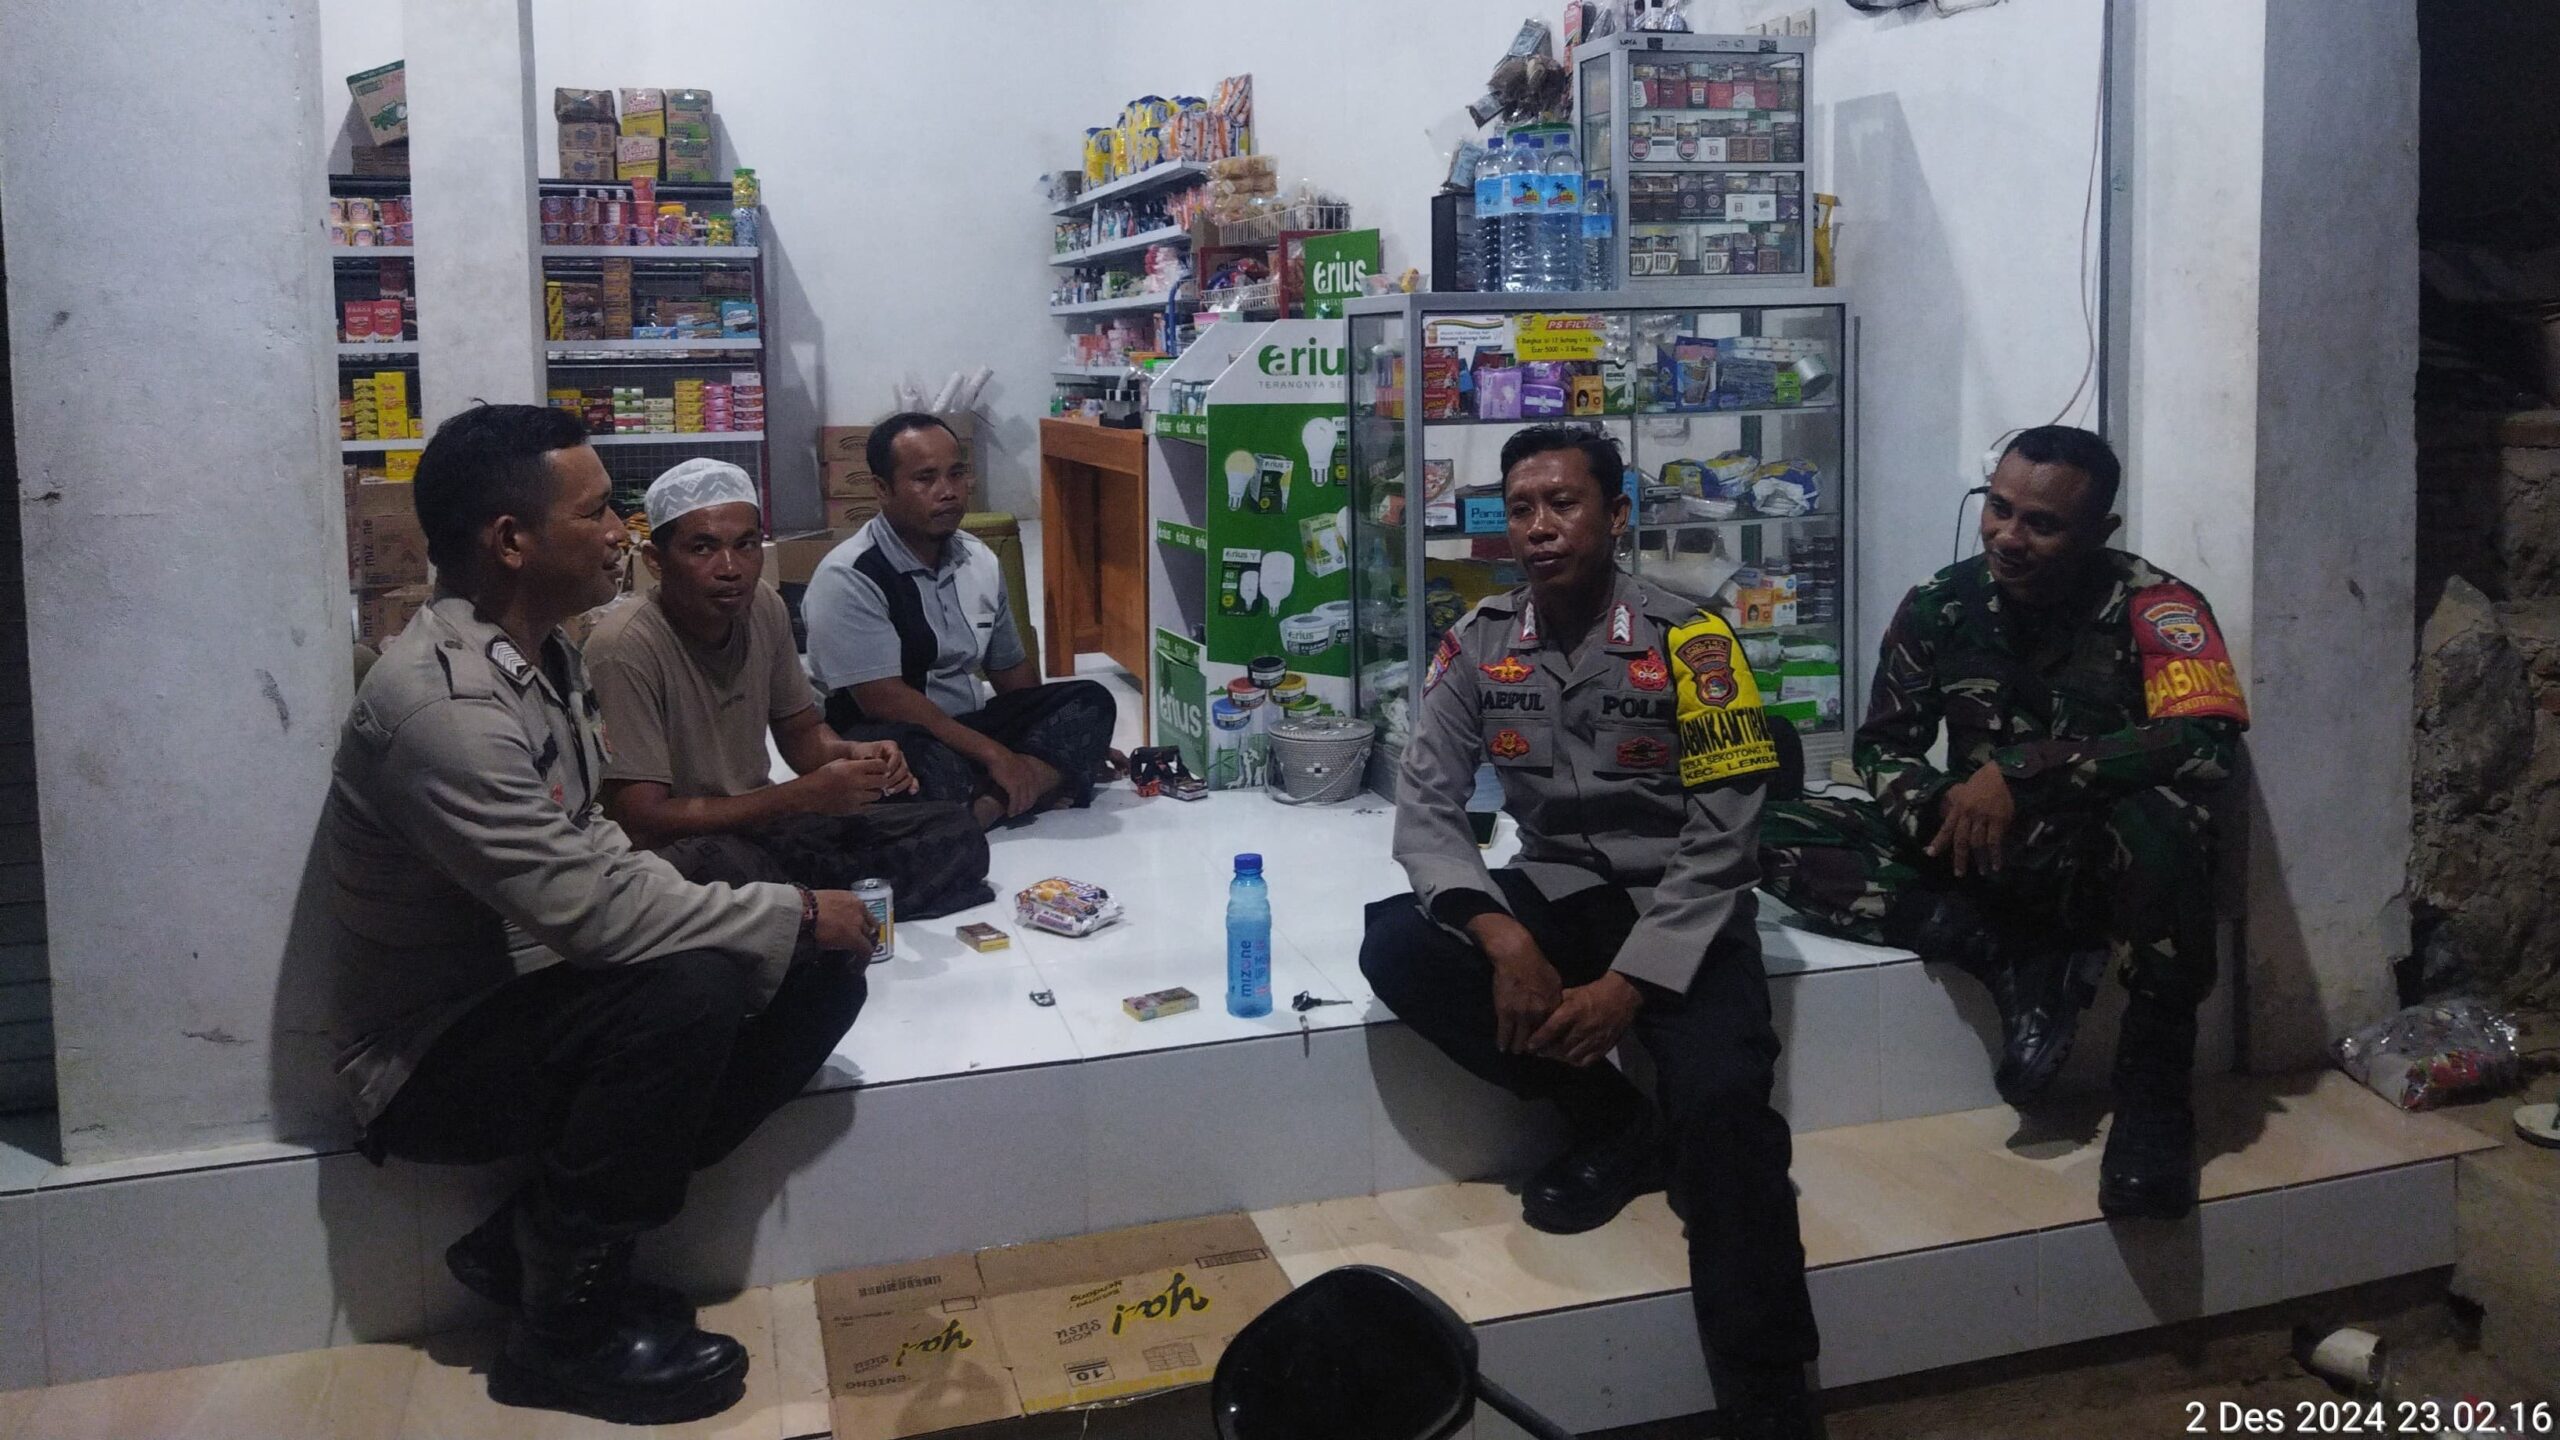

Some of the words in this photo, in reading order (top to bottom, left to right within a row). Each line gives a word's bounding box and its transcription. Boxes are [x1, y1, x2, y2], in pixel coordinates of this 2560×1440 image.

[1259, 380, 1326, 390] TERANGNYA
[1479, 690, 1545, 711] AEPUL
[1602, 695, 1668, 719] POL
[1240, 940, 1253, 998] mizone
[1059, 1330, 1092, 1346] KOPI
[1076, 1369, 1104, 1382] 10
